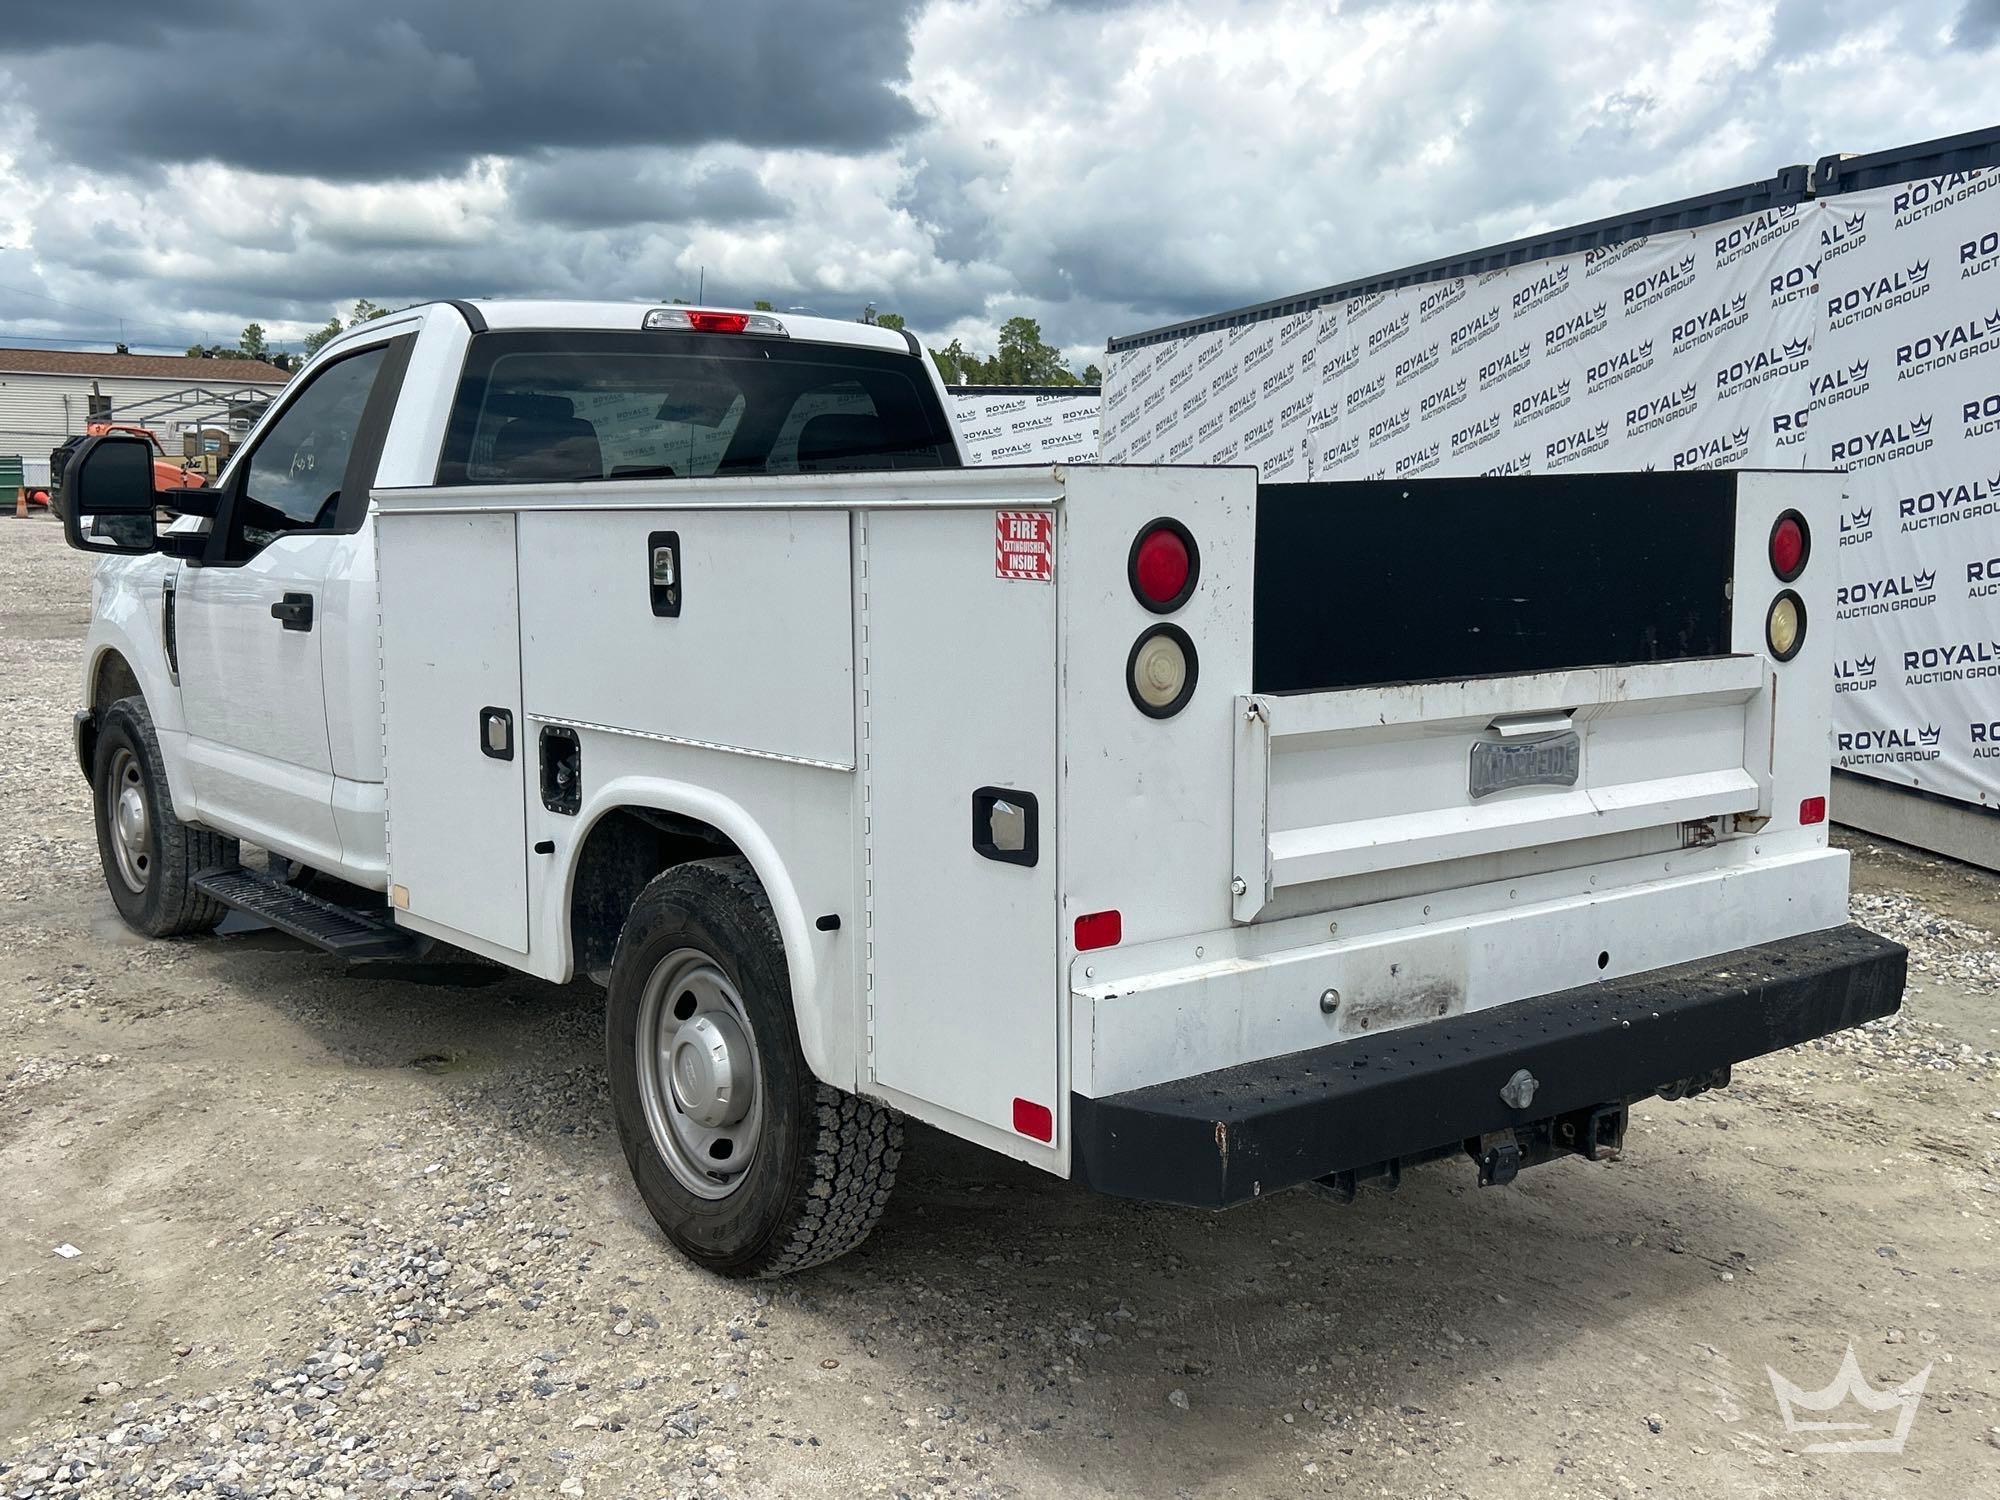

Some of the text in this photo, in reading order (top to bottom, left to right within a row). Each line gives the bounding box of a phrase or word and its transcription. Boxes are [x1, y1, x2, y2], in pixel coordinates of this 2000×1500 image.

[1895, 173, 2000, 229] AUCTION GROU
[1715, 211, 1778, 257] ROYAL
[1716, 240, 1759, 270] AUCTION
[1761, 219, 1799, 245] GROUP
[1825, 235, 1866, 261] GROUP
[1585, 252, 1620, 278] AUCTION
[1622, 236, 1648, 258] GROUP
[1624, 266, 1679, 305] ROYAL
[1770, 259, 1822, 295] ROY
[1420, 284, 1455, 314] ROYAL
[1512, 274, 1556, 309] ROYAL
[1513, 282, 1569, 319] AUCTION GROUP
[1625, 274, 1695, 317] AUCTION GROUP
[1828, 273, 1906, 318] ROYAL
[1421, 290, 1466, 324] AUCTION GROUP
[1829, 284, 1930, 331] AUCTION GROUP
[1281, 315, 1306, 339] ROYAL
[1369, 320, 1400, 347] ROYAL
[1450, 315, 1489, 346] ROYAL
[1545, 312, 1593, 346] ROYAL
[1672, 304, 1730, 344] ROYAL
[1672, 313, 1748, 356] AUCTION GROUP
[1451, 323, 1499, 356] AUCTION GROUP
[1546, 320, 1607, 357] AUCTION GROUP
[1897, 321, 1983, 366] ROYAL
[1244, 343, 1268, 366] ROYAL
[1323, 351, 1351, 377] ROYAL
[1395, 350, 1429, 378] ROYAL
[1479, 350, 1519, 381] ROYAL
[1587, 349, 1638, 383] ROYAL
[1717, 348, 1782, 388] ROYAL
[1898, 337, 2000, 381] AUCTION GROU
[1263, 368, 1287, 392] ROYAL
[1396, 358, 1439, 388] AUCTION GROUP
[1480, 360, 1530, 392] AUCTION GROUP
[1588, 359, 1654, 395] AUCTION GROUP
[1718, 359, 1809, 401] AUCTION GROUP
[1810, 370, 1848, 396] YAL
[986, 402, 1014, 413] ROYAL
[1229, 393, 1250, 416] ROYAL
[1347, 381, 1376, 406] ROYAL
[1420, 385, 1456, 412] ROYAL
[1421, 394, 1467, 421] AUCTION GROUP
[1513, 387, 1557, 418] ROYAL
[1829, 383, 1869, 404] GROUP
[1062, 409, 1095, 420] ROYAL
[1281, 399, 1306, 421] ROYAL
[1513, 397, 1571, 428] AUCTION GROUP
[1626, 392, 1681, 426] ROYAL
[1627, 402, 1697, 438] AUCTION GROUP
[1012, 417, 1044, 430] ROYAL
[1244, 423, 1267, 443] ROYAL
[1369, 414, 1400, 440] ROYAL
[1452, 420, 1489, 447] ROYAL
[992, 445, 1022, 456] ROYAL
[1041, 434, 1073, 446] ROYAL
[1323, 441, 1351, 462] ROYAL
[1452, 429, 1500, 457] AUCTION GROUP
[1546, 428, 1595, 458] ROYAL
[1673, 436, 1732, 471] ROYAL
[1832, 424, 1909, 462] ROYAL
[1888, 439, 1933, 460] GROUP
[1264, 451, 1287, 472] ROYAL
[1396, 449, 1430, 473] ROYAL
[1547, 439, 1609, 470] AUCTION GROUP
[1715, 448, 1748, 467] GROUP
[1900, 482, 1987, 518] ROYAL
[1010, 521, 1037, 539] FIRE
[1901, 512, 1960, 533] AUCTION
[1004, 541, 1045, 554] EXTINGUISHER
[1840, 531, 1872, 547] ROUP
[1009, 555, 1038, 570] INSIDE
[1837, 576, 1913, 606] ROYAL
[1836, 594, 1936, 620] AUCTION GROUP
[1904, 643, 1991, 670] ROYAL
[1835, 680, 1877, 693] GROUP
[1905, 670, 1962, 685] AUCTION
[1838, 729, 1915, 751] ROYAL
[1840, 751, 1940, 765] AUCTION GROUP
